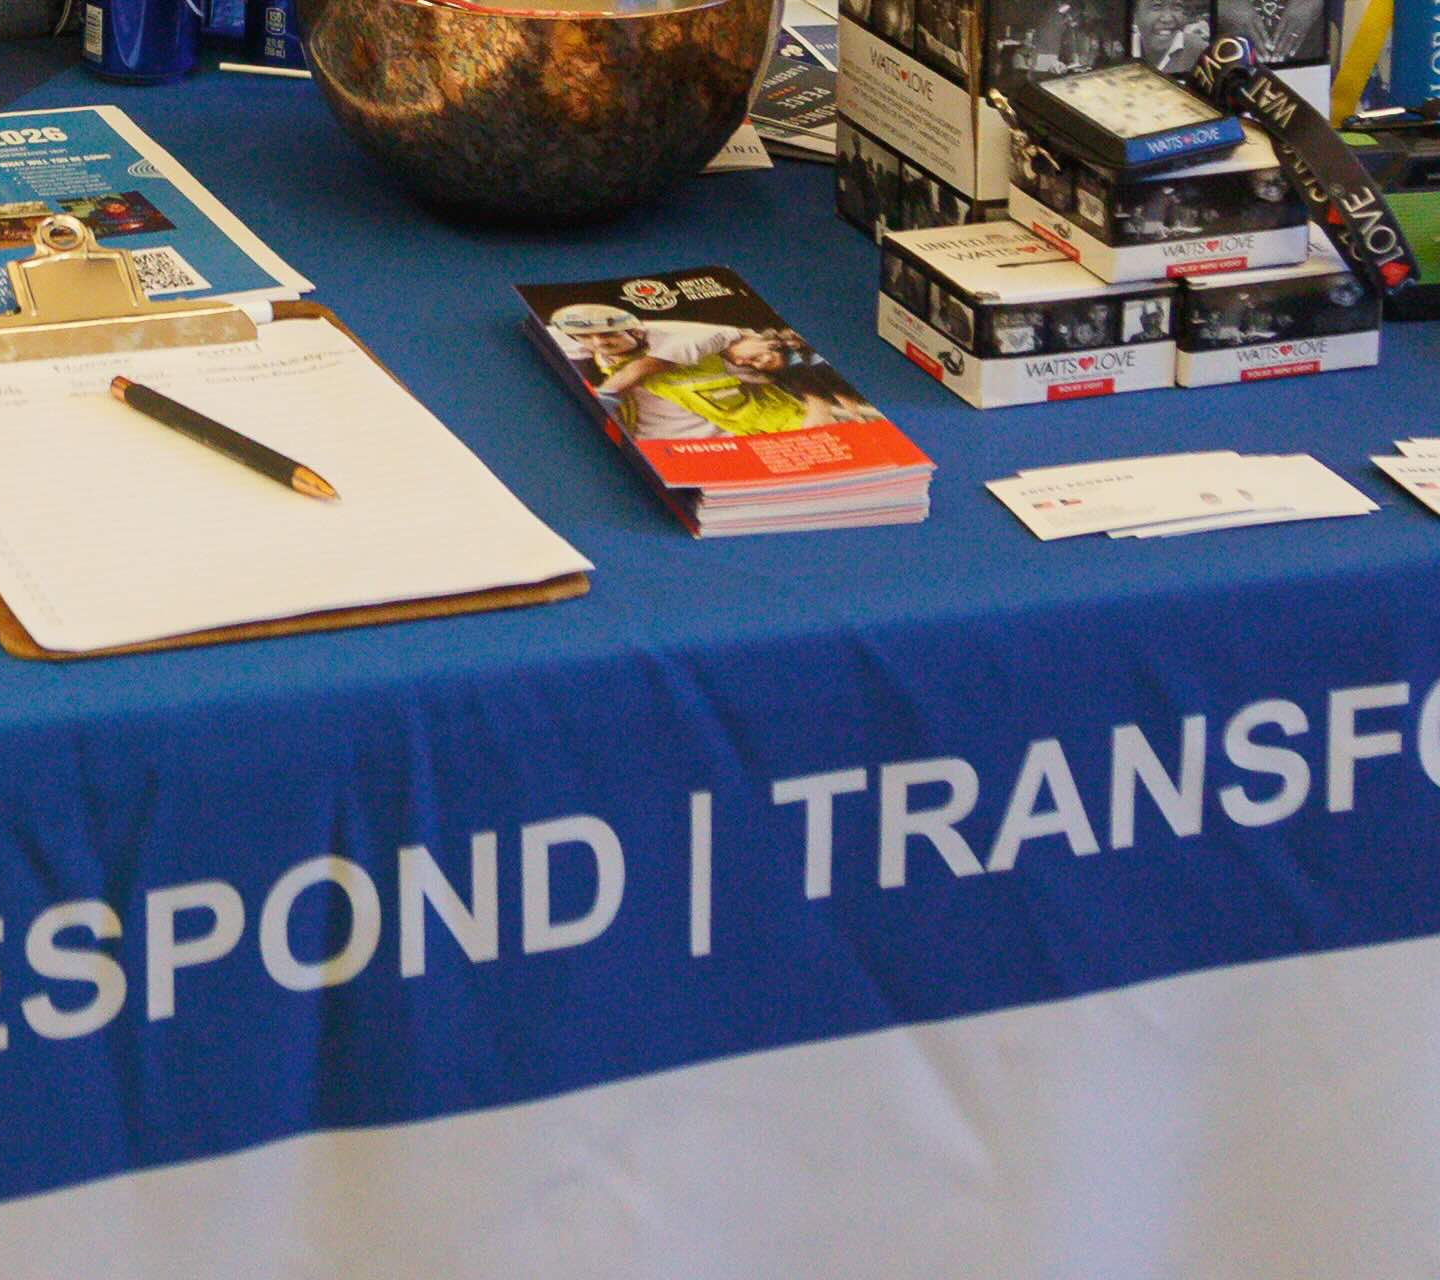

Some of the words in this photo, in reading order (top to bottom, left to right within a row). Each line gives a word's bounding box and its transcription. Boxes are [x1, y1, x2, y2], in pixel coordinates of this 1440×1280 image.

[1161, 240, 1206, 257] WATTS
[1219, 235, 1255, 251] LOVE
[1237, 346, 1279, 363] WATTS
[1292, 340, 1328, 356] LOVE
[1025, 359, 1077, 378] WATTS
[1094, 350, 1136, 371] LOVE
